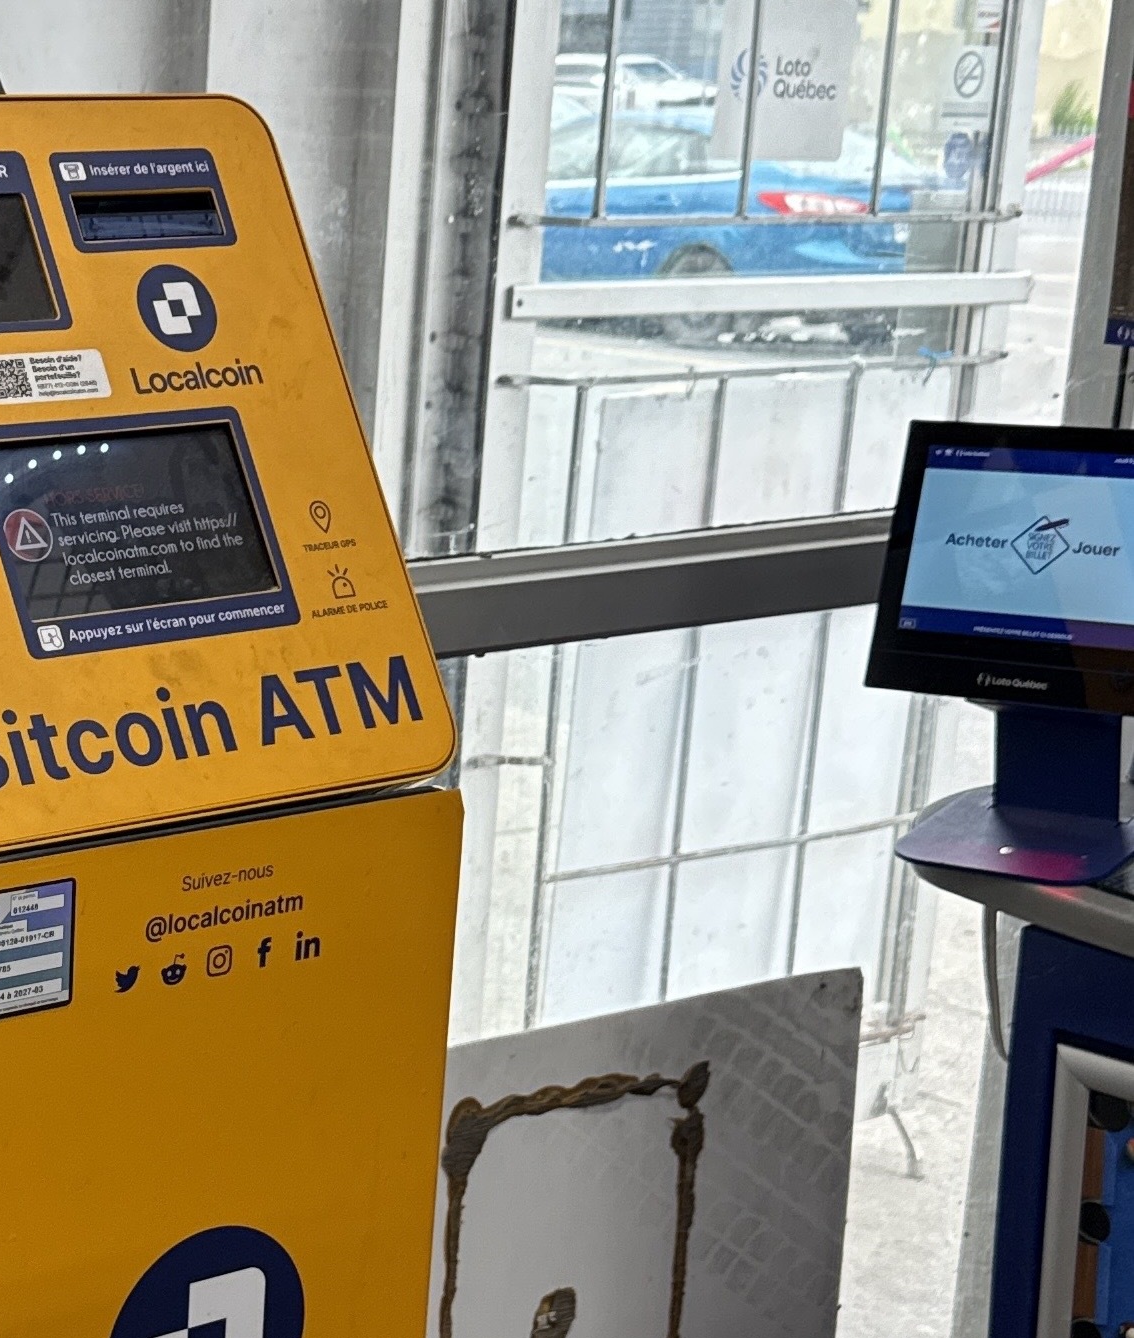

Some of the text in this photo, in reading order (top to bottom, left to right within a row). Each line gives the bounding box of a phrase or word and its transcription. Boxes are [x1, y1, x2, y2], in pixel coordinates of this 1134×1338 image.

[775, 56, 811, 77] Loto
[773, 78, 837, 100] Québec
[88, 160, 210, 176] Insérer de l'argent ici
[129, 358, 264, 394] Localcoin
[50, 502, 185, 528] This terminal requires
[58, 512, 238, 547] servicing. Please visit https://
[945, 532, 1010, 550] Acheter
[62, 531, 244, 567] localcoinatm.com to find the
[303, 538, 357, 553] TRACEUR GPS
[1071, 541, 1121, 557] Jouer
[69, 559, 173, 586] closest terminal.
[311, 600, 389, 619] ALARME DE POLICE
[69, 603, 286, 643] Appuyez sur l'écran pour commencer
[260, 655, 424, 747] ATM
[181, 864, 274, 892] Suivez-nous
[145, 894, 304, 943] @localcoinatm
